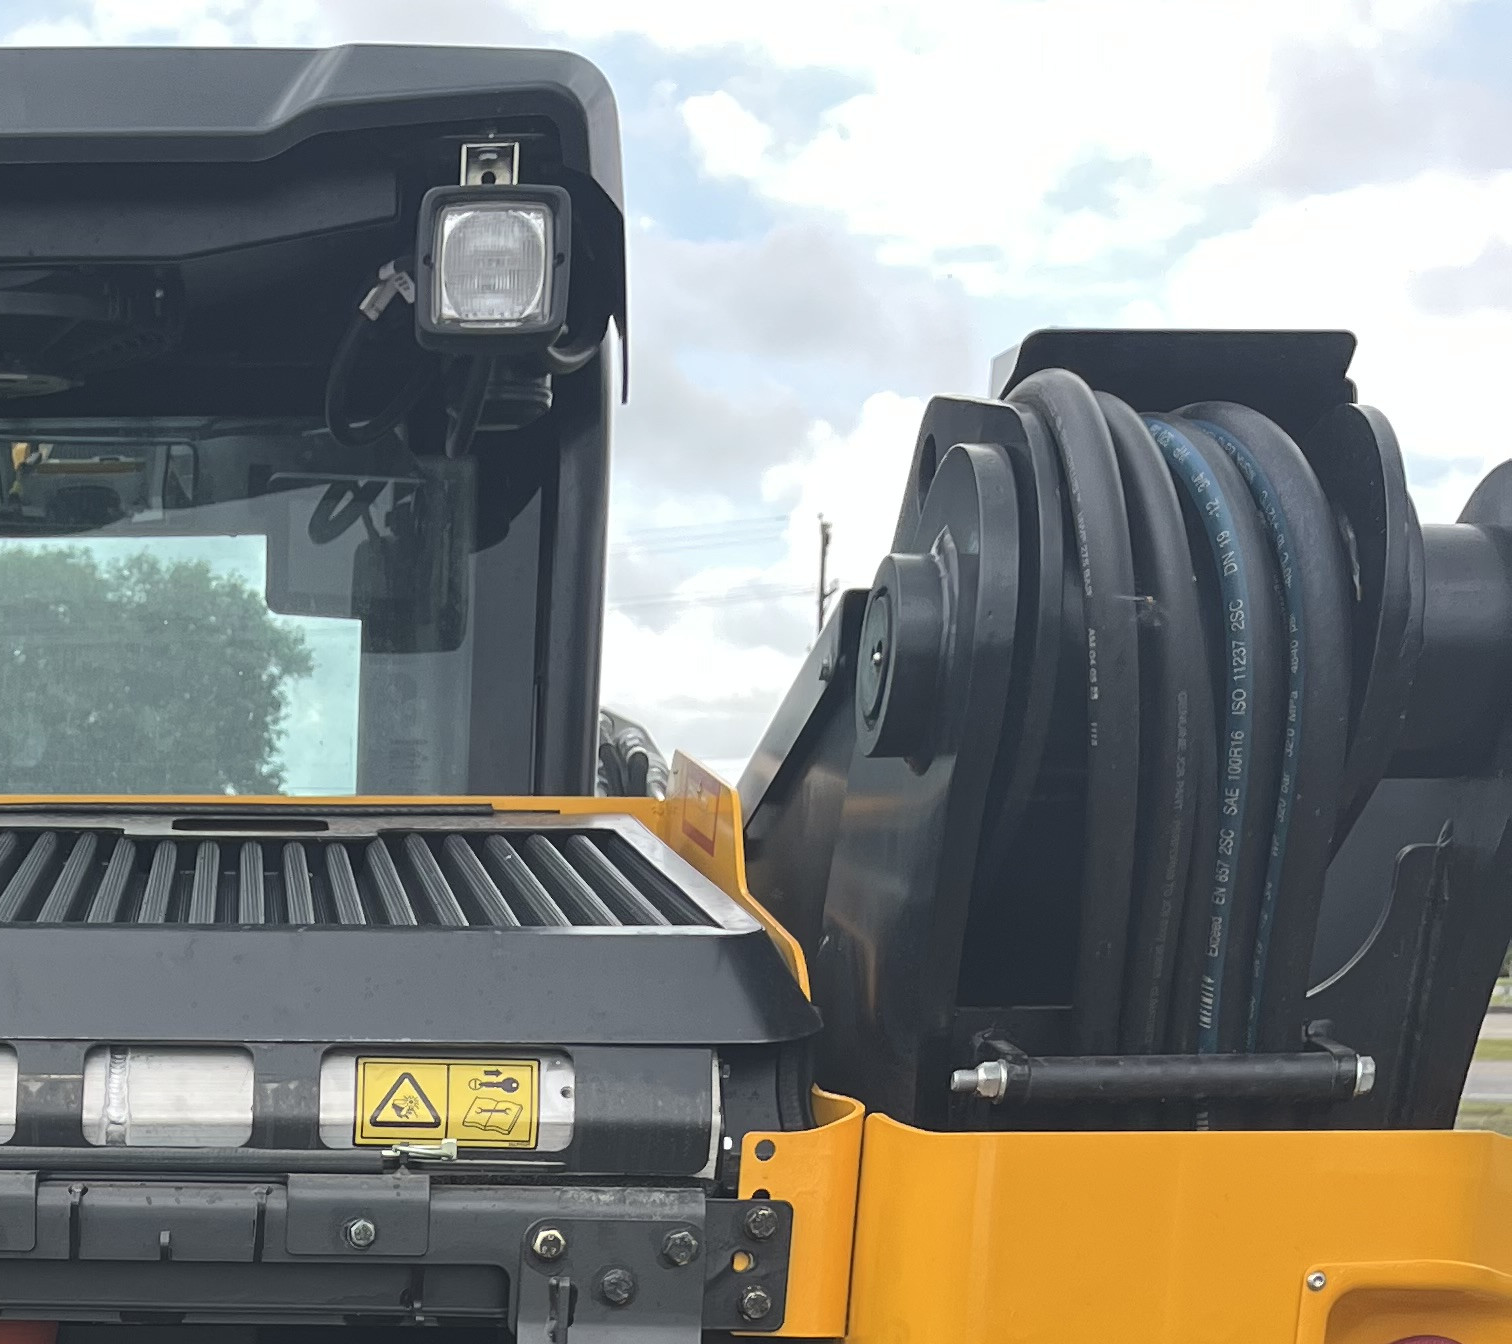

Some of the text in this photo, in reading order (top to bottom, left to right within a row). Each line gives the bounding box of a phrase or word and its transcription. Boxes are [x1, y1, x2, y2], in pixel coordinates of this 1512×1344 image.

[1221, 550, 1238, 576] DN
[1228, 598, 1245, 632] 2SC
[1232, 639, 1247, 681] 11237
[1231, 688, 1247, 715] ISO
[1227, 730, 1245, 781] 100R16
[1222, 787, 1240, 816] SAE
[1218, 828, 1235, 855] 2SC
[1211, 886, 1227, 905] EN
